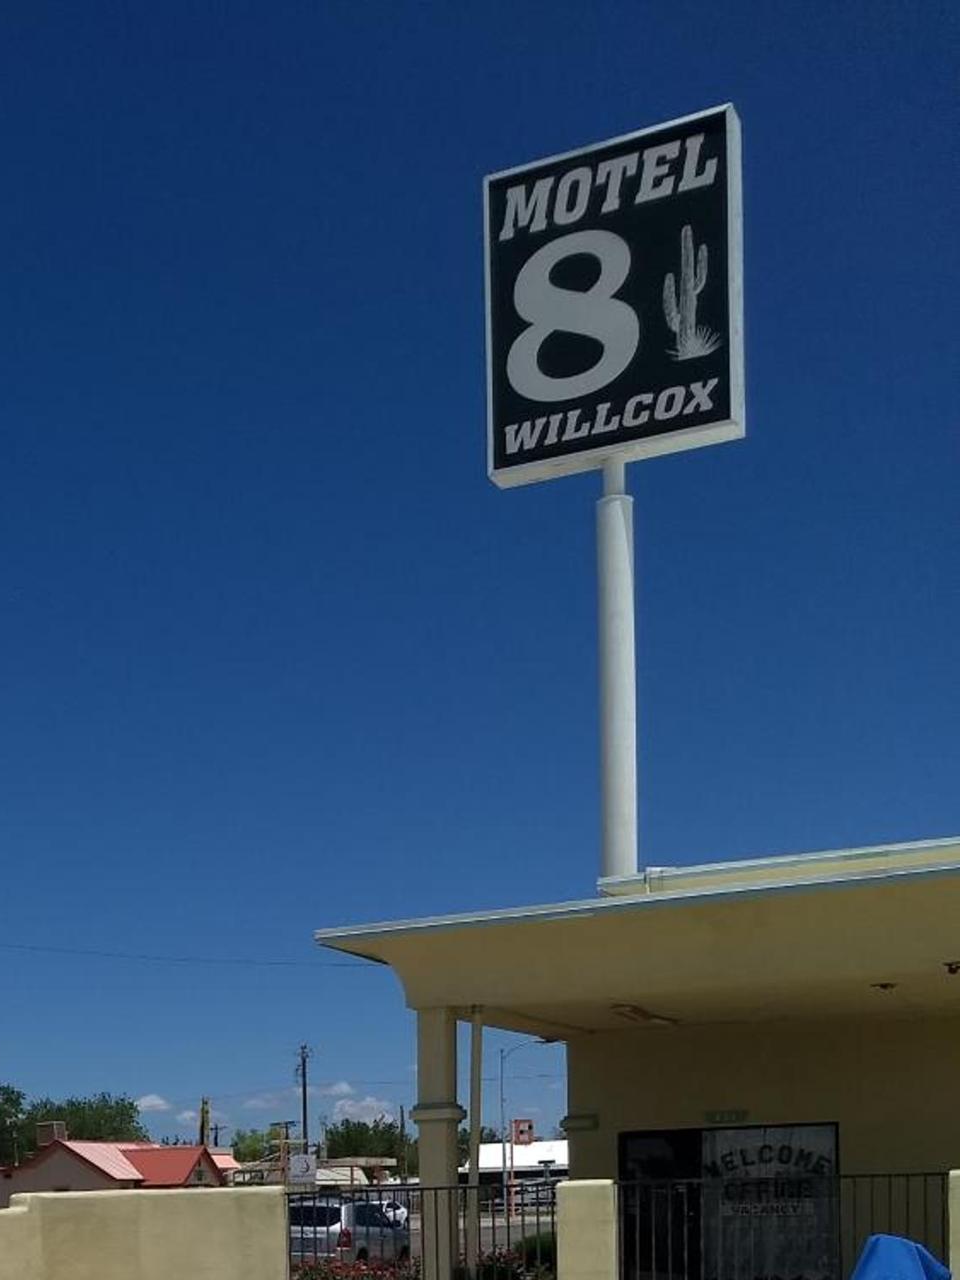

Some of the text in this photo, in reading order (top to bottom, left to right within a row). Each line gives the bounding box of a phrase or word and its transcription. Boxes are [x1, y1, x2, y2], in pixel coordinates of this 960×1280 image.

[499, 133, 718, 241] MOTEL
[506, 229, 640, 402] 8
[504, 377, 719, 455] WILLCOX
[703, 1143, 833, 1178] WELCOME
